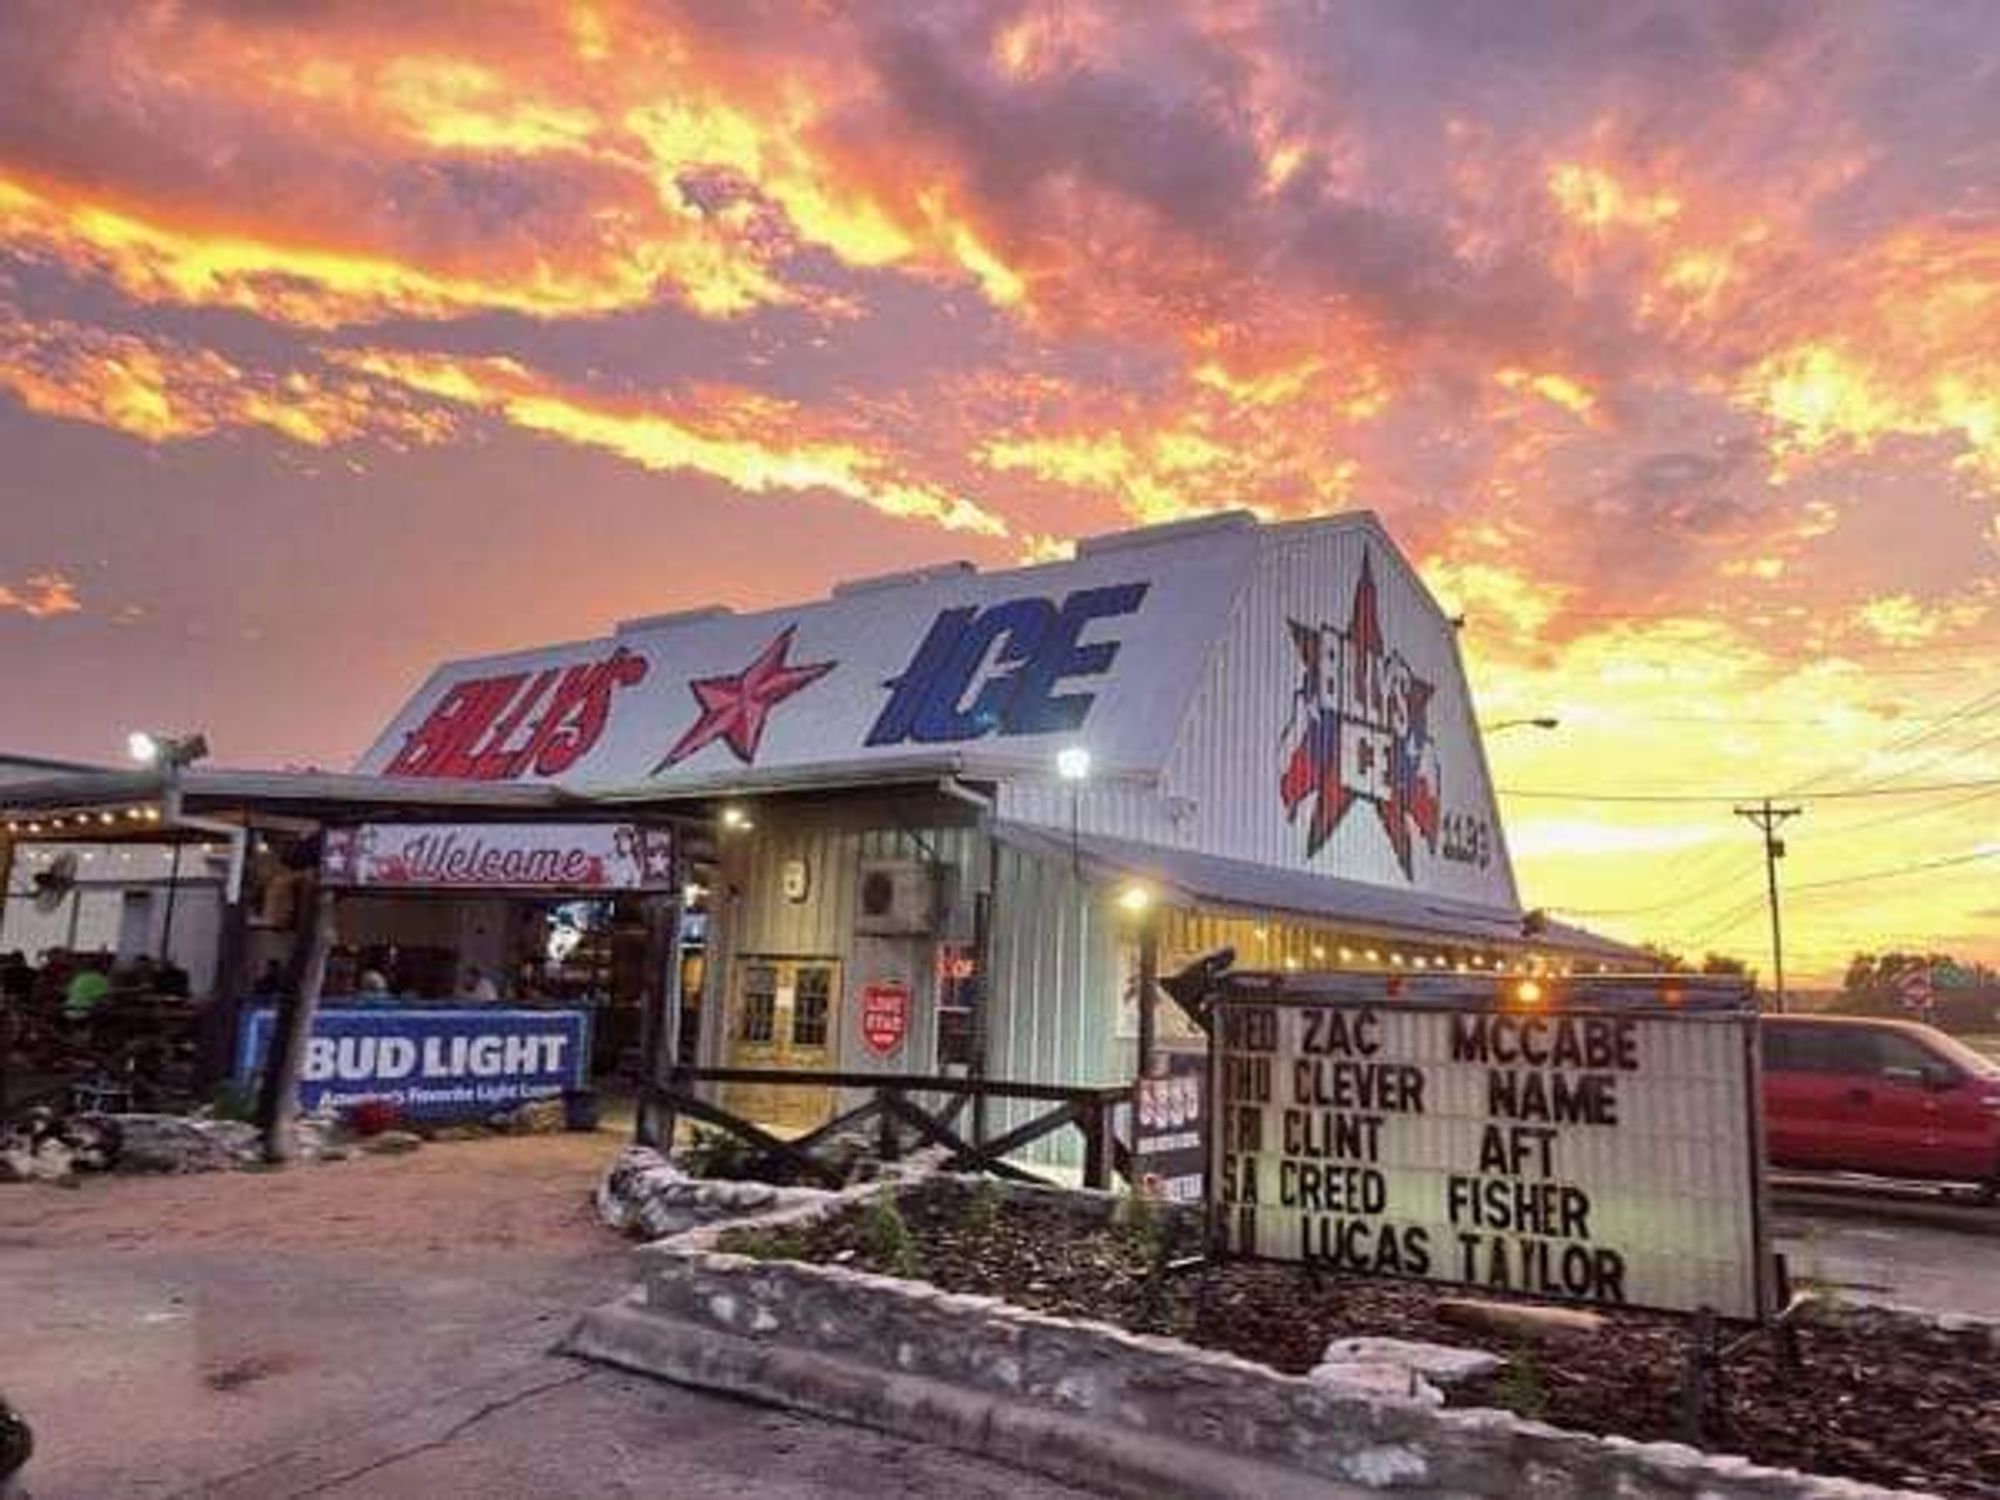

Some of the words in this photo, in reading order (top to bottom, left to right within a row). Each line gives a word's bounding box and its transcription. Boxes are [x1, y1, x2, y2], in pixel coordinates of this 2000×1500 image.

[864, 583, 1150, 746] ICE
[403, 831, 589, 883] Welcome
[301, 1036, 417, 1081] BUD
[422, 1034, 568, 1078] LIGHT
[1302, 1008, 1380, 1056] ZAC
[1451, 1013, 1639, 1071] MCCABE
[1294, 1059, 1424, 1114] CLEVER
[1488, 1069, 1618, 1126] NAME
[1283, 1109, 1384, 1163] CLINT
[1480, 1124, 1557, 1178] AFT
[1279, 1160, 1387, 1215] CREED
[1449, 1177, 1592, 1239] FISHER
[1302, 1215, 1431, 1275] LUCAS
[1458, 1232, 1627, 1303] TAYLOR
